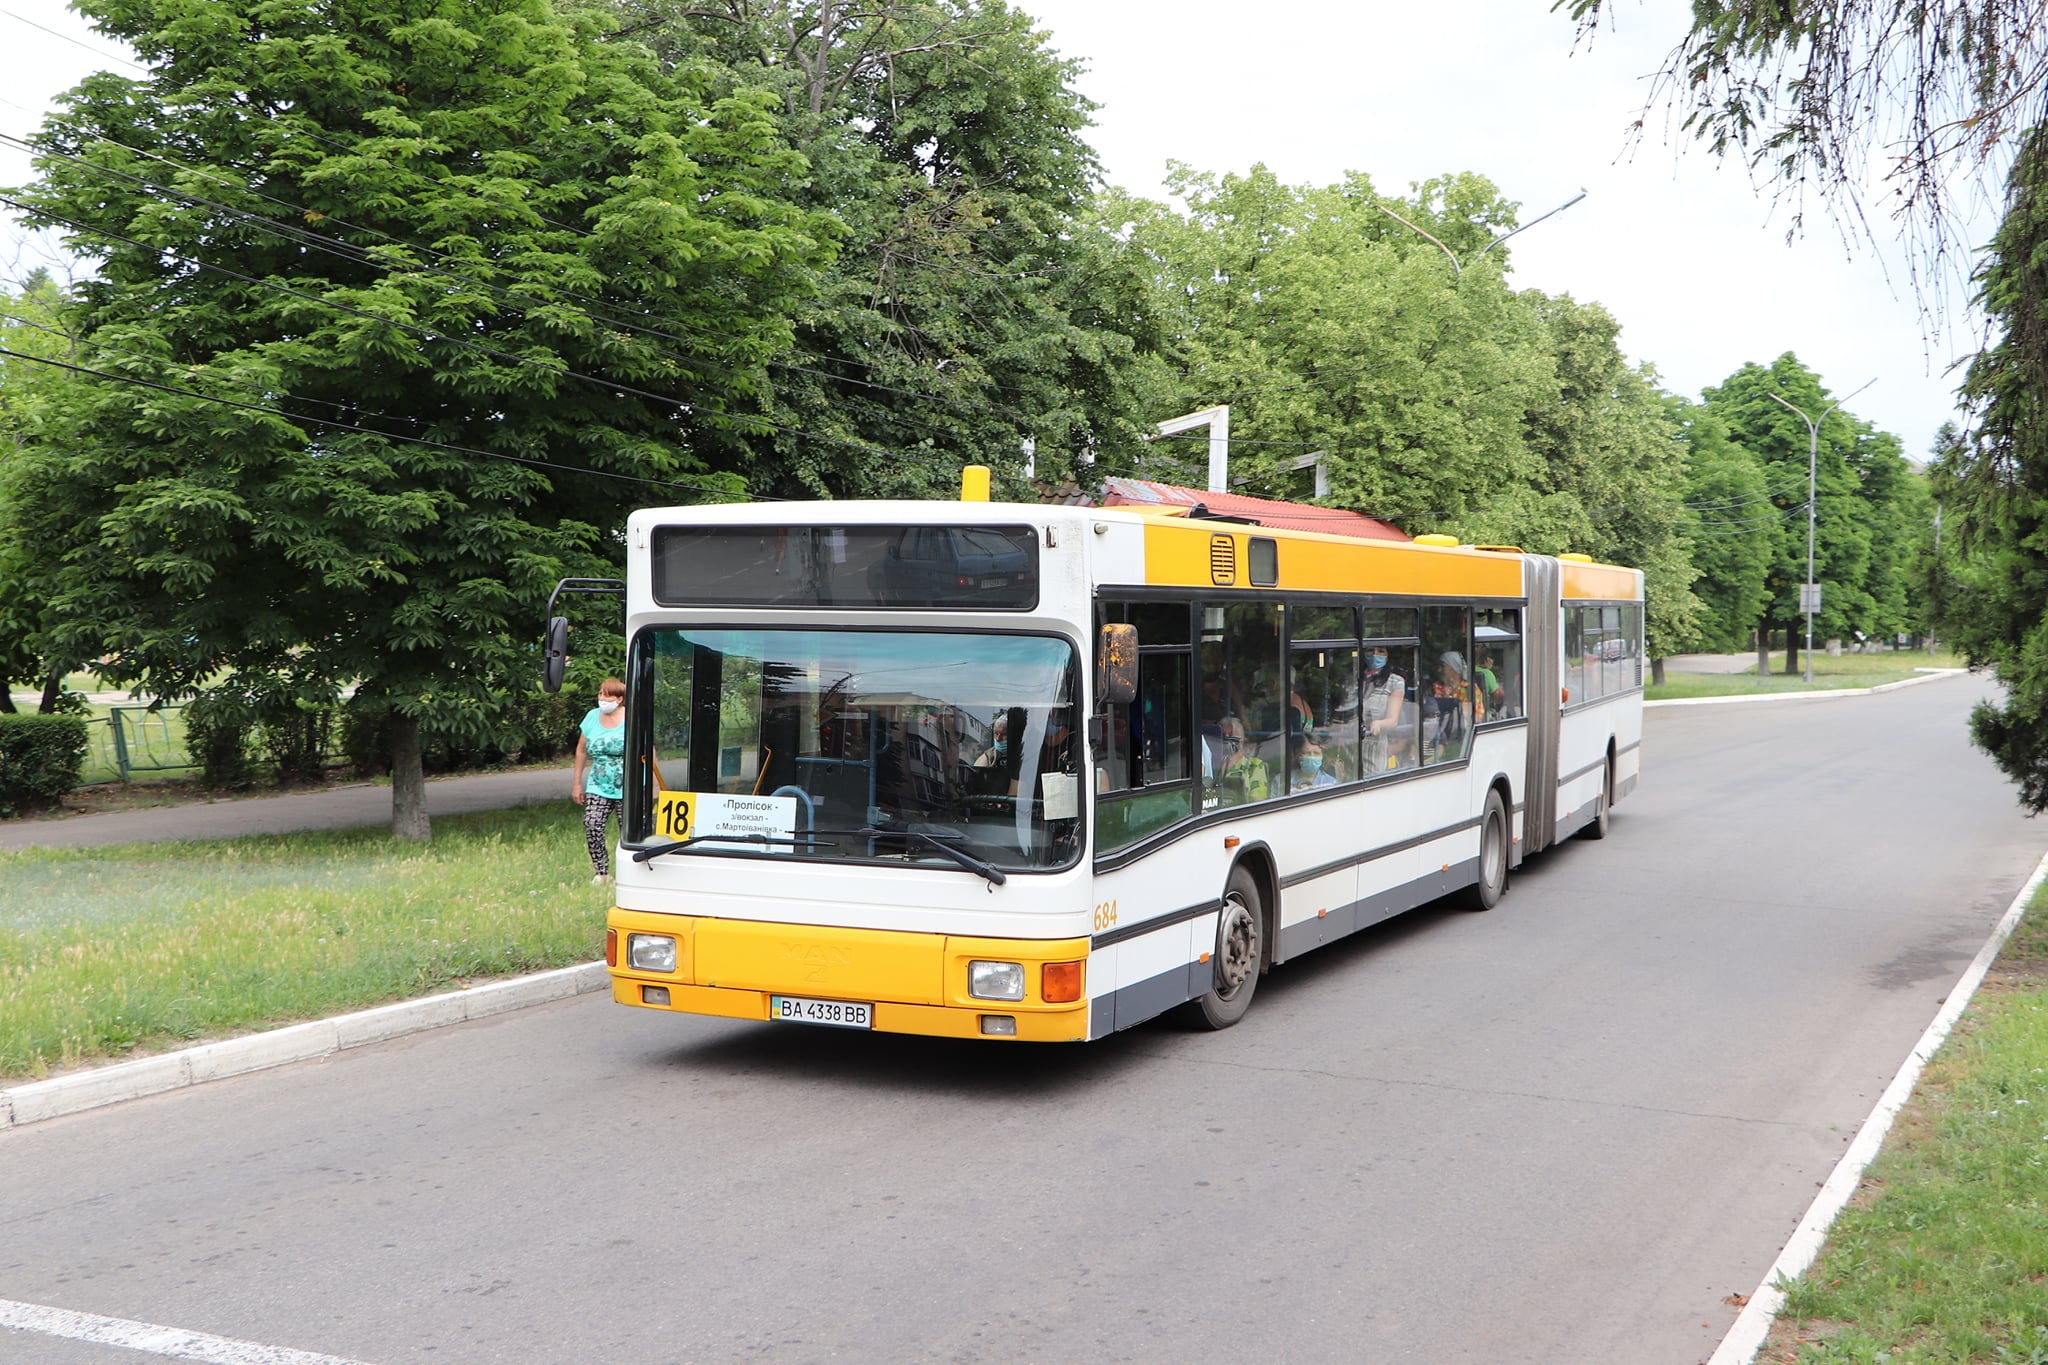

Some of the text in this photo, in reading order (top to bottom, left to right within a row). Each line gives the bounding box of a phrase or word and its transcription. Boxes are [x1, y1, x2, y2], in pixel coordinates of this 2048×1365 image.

[1202, 797, 1218, 809] MAN
[662, 800, 689, 835] 18
[1093, 899, 1118, 931] 684
[781, 1000, 867, 1024] BA 4338 BB
